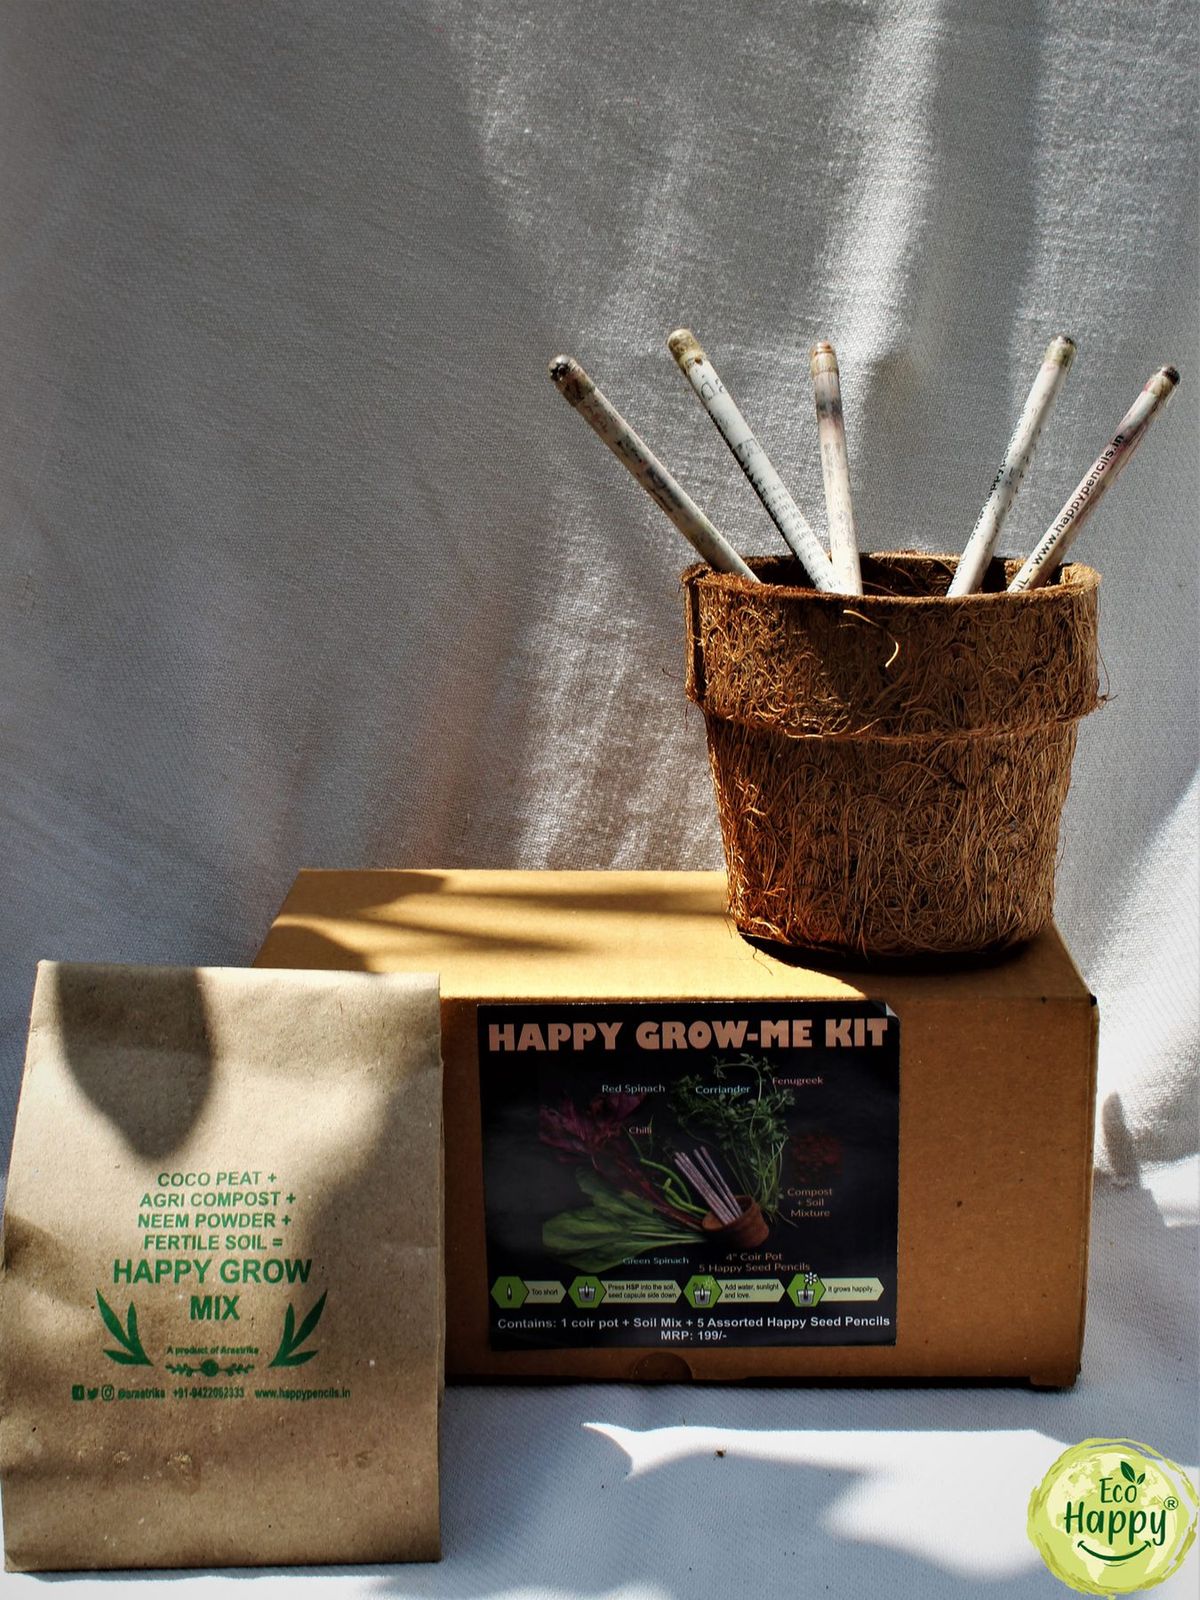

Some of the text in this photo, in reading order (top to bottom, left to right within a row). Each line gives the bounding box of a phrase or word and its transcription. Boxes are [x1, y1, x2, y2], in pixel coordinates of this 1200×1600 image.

[1031, 433, 1124, 566] www.happypencils.in
[488, 1018, 888, 1052] HAPPY GROW-ME KIT
[772, 1076, 823, 1086] Fenugreek
[601, 1084, 665, 1095] Red Spinach
[695, 1085, 751, 1095] Corriander
[629, 1125, 652, 1134] Chilli
[158, 1172, 210, 1187] COCO
[216, 1171, 262, 1186] PEAT
[787, 1188, 833, 1198] Compost
[140, 1193, 184, 1207] AGRI
[190, 1191, 281, 1207] COMPOST
[806, 1198, 824, 1206] Soil
[791, 1209, 830, 1217] Mixture
[138, 1214, 189, 1228] NEEM
[195, 1213, 276, 1228] POWDER
[144, 1234, 220, 1250] FERTILE
[225, 1234, 267, 1250] SOIL
[622, 1256, 689, 1266] Green Spinach
[740, 1252, 762, 1261] Coir
[765, 1252, 783, 1261] Pot
[113, 1258, 312, 1284] HAPPY GROW
[709, 1263, 742, 1274] Happy
[746, 1263, 771, 1272] Seed
[774, 1262, 810, 1272] Pencils
[532, 1288, 559, 1296] Too short
[608, 1283, 624, 1291] Press
[626, 1283, 639, 1291] HSP
[641, 1283, 651, 1291] into
[653, 1283, 662, 1291] the
[724, 1282, 736, 1291] Add
[756, 1282, 779, 1292] sunlight
[833, 1286, 852, 1295] grows
[608, 1291, 622, 1299] seed
[623, 1291, 646, 1300] capsule
[648, 1291, 659, 1299] side
[724, 1291, 736, 1299] and
[190, 1295, 240, 1320] MIX
[497, 1318, 557, 1330] Contains:
[571, 1318, 595, 1328] coir
[599, 1318, 619, 1331] pot
[633, 1317, 657, 1328] Soil
[660, 1317, 682, 1328] Mix
[697, 1317, 704, 1328] 5
[708, 1316, 760, 1328] Assorted
[767, 1317, 807, 1330] Happy
[811, 1316, 841, 1327] Seed
[845, 1315, 890, 1327] Pencils
[660, 1330, 727, 1341] MRP: 199/-
[175, 1346, 208, 1357] product
[210, 1345, 219, 1354] of
[255, 1386, 351, 1400] www.happypencils.in
